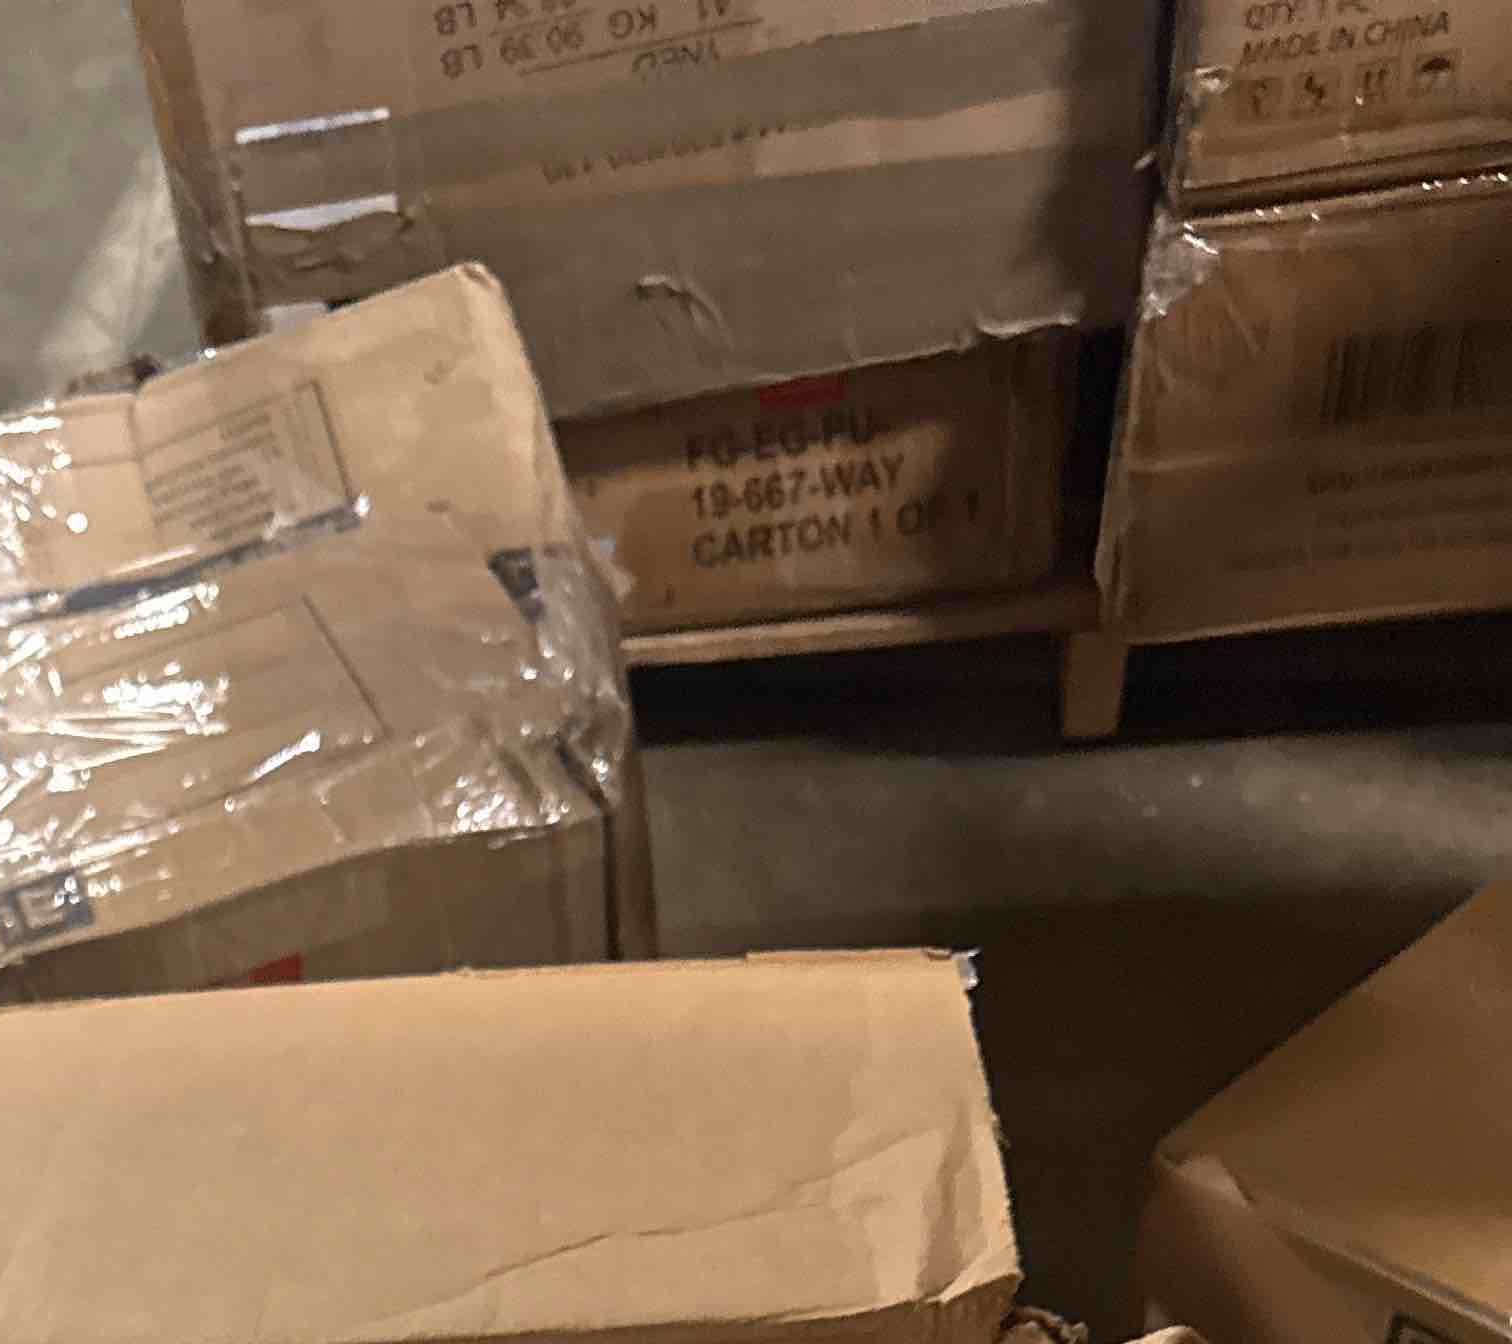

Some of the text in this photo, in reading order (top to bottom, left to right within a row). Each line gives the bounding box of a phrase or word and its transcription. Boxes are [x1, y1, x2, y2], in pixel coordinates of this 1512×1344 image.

[607, 4, 656, 39] KG
[1240, 31, 1320, 66] MADE
[1364, 10, 1449, 47] CHINA
[691, 513, 852, 567] CARTON
